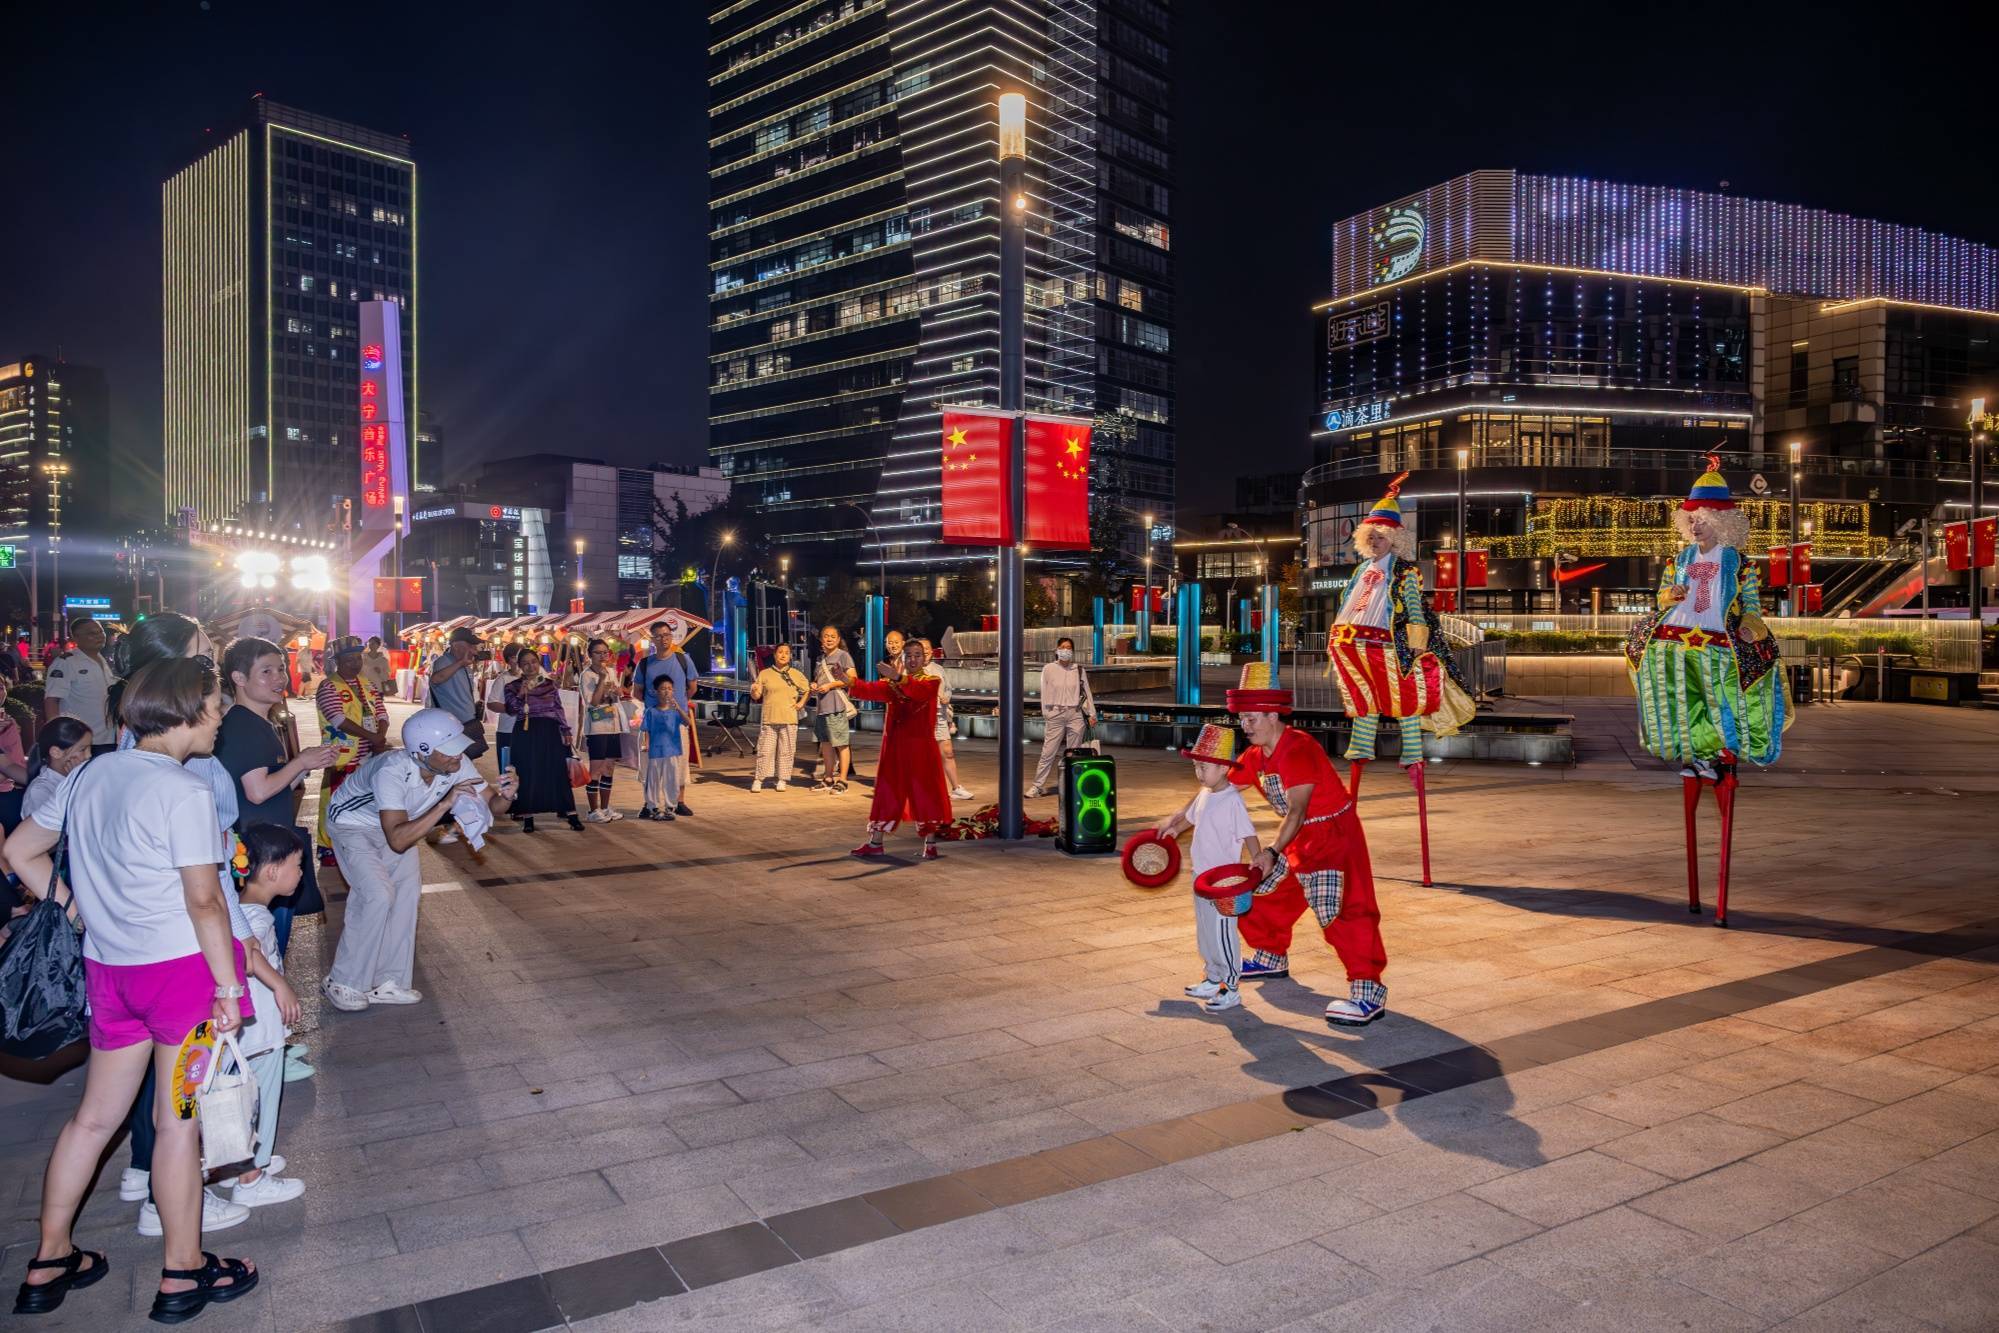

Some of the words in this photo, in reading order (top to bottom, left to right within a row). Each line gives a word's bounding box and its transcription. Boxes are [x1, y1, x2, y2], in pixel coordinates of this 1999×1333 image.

[360, 382, 377, 505] 大宁音乐广场
[1754, 478, 1764, 490] C
[1311, 579, 1352, 590] STARBUCK
[1088, 799, 1102, 808] JBL
